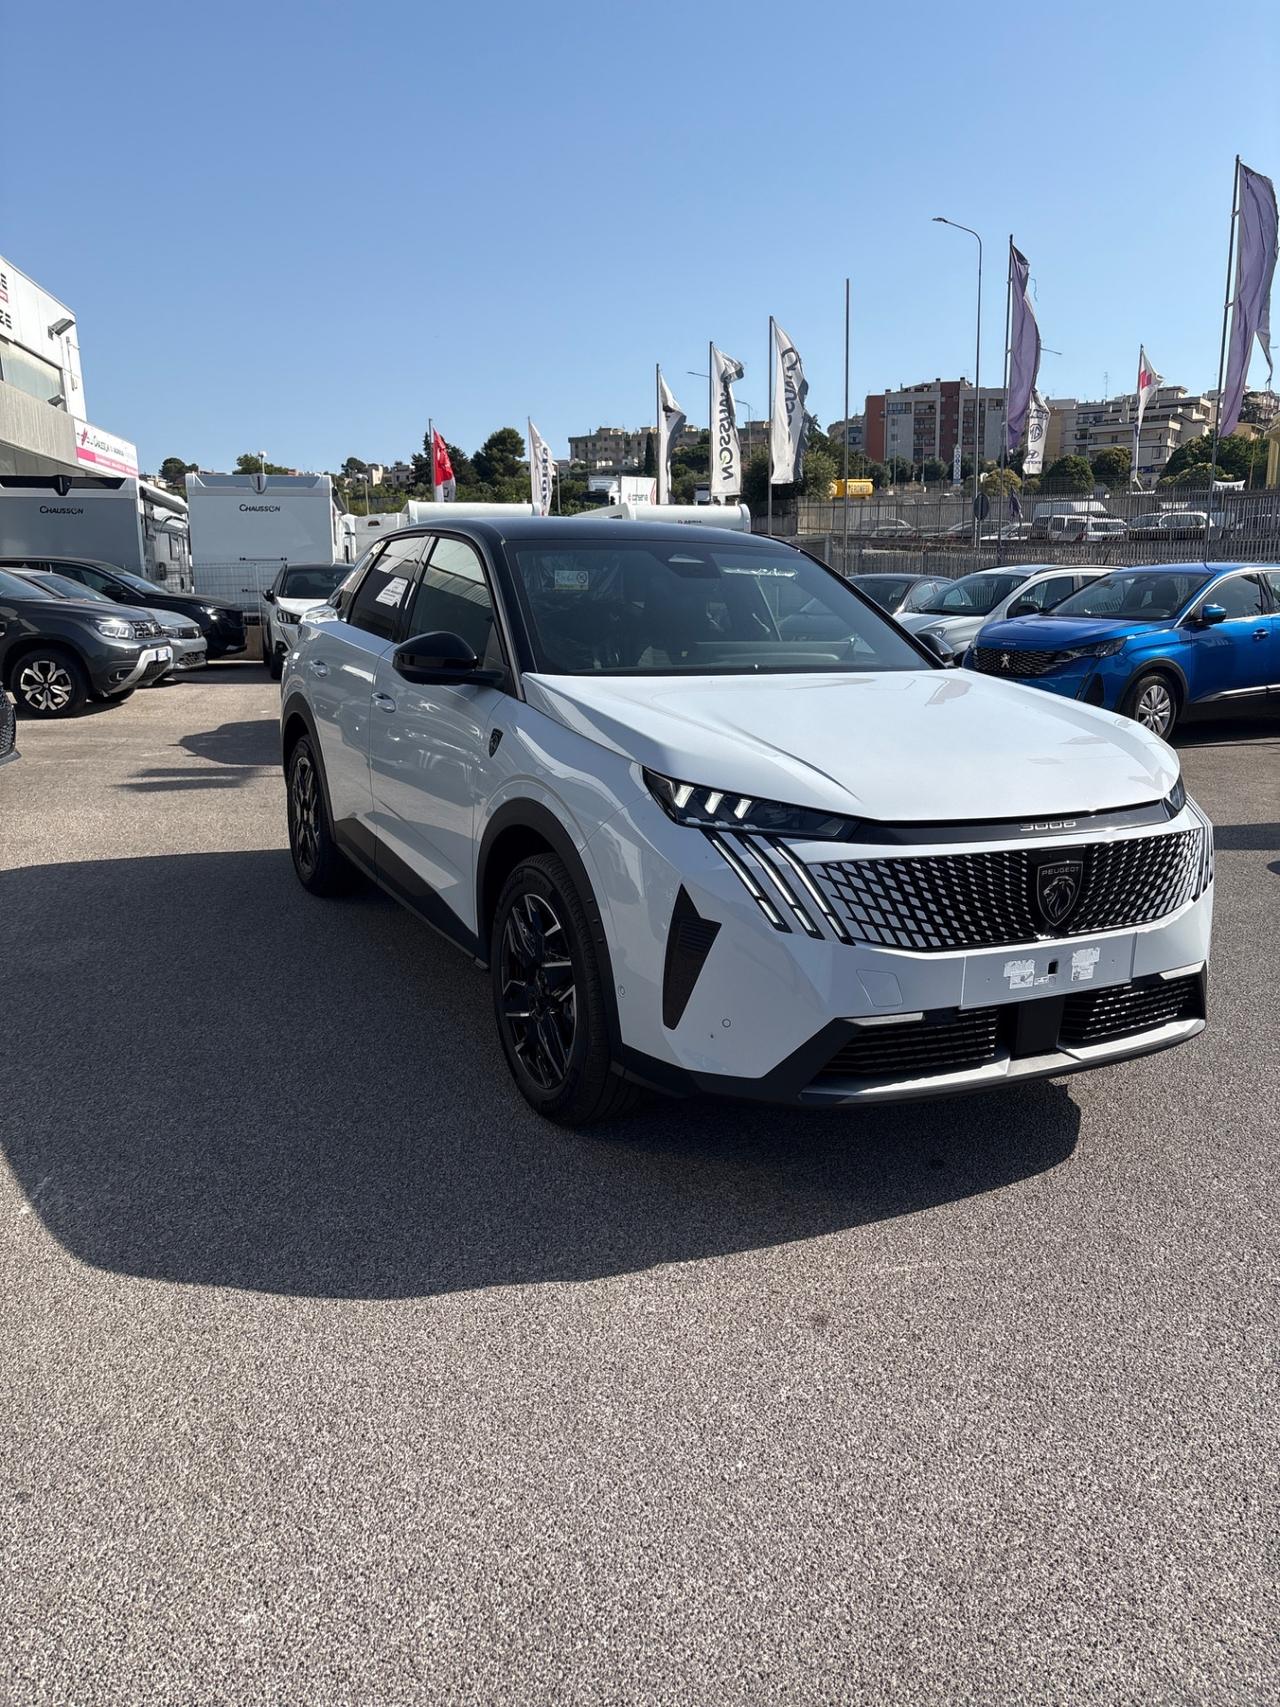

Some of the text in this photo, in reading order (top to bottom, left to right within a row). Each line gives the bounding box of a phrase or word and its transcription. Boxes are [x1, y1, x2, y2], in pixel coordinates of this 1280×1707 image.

[39, 505, 84, 515] CHAUSSON
[239, 503, 281, 513] CHAUSSON
[1041, 866, 1080, 875] PEUGEOT
